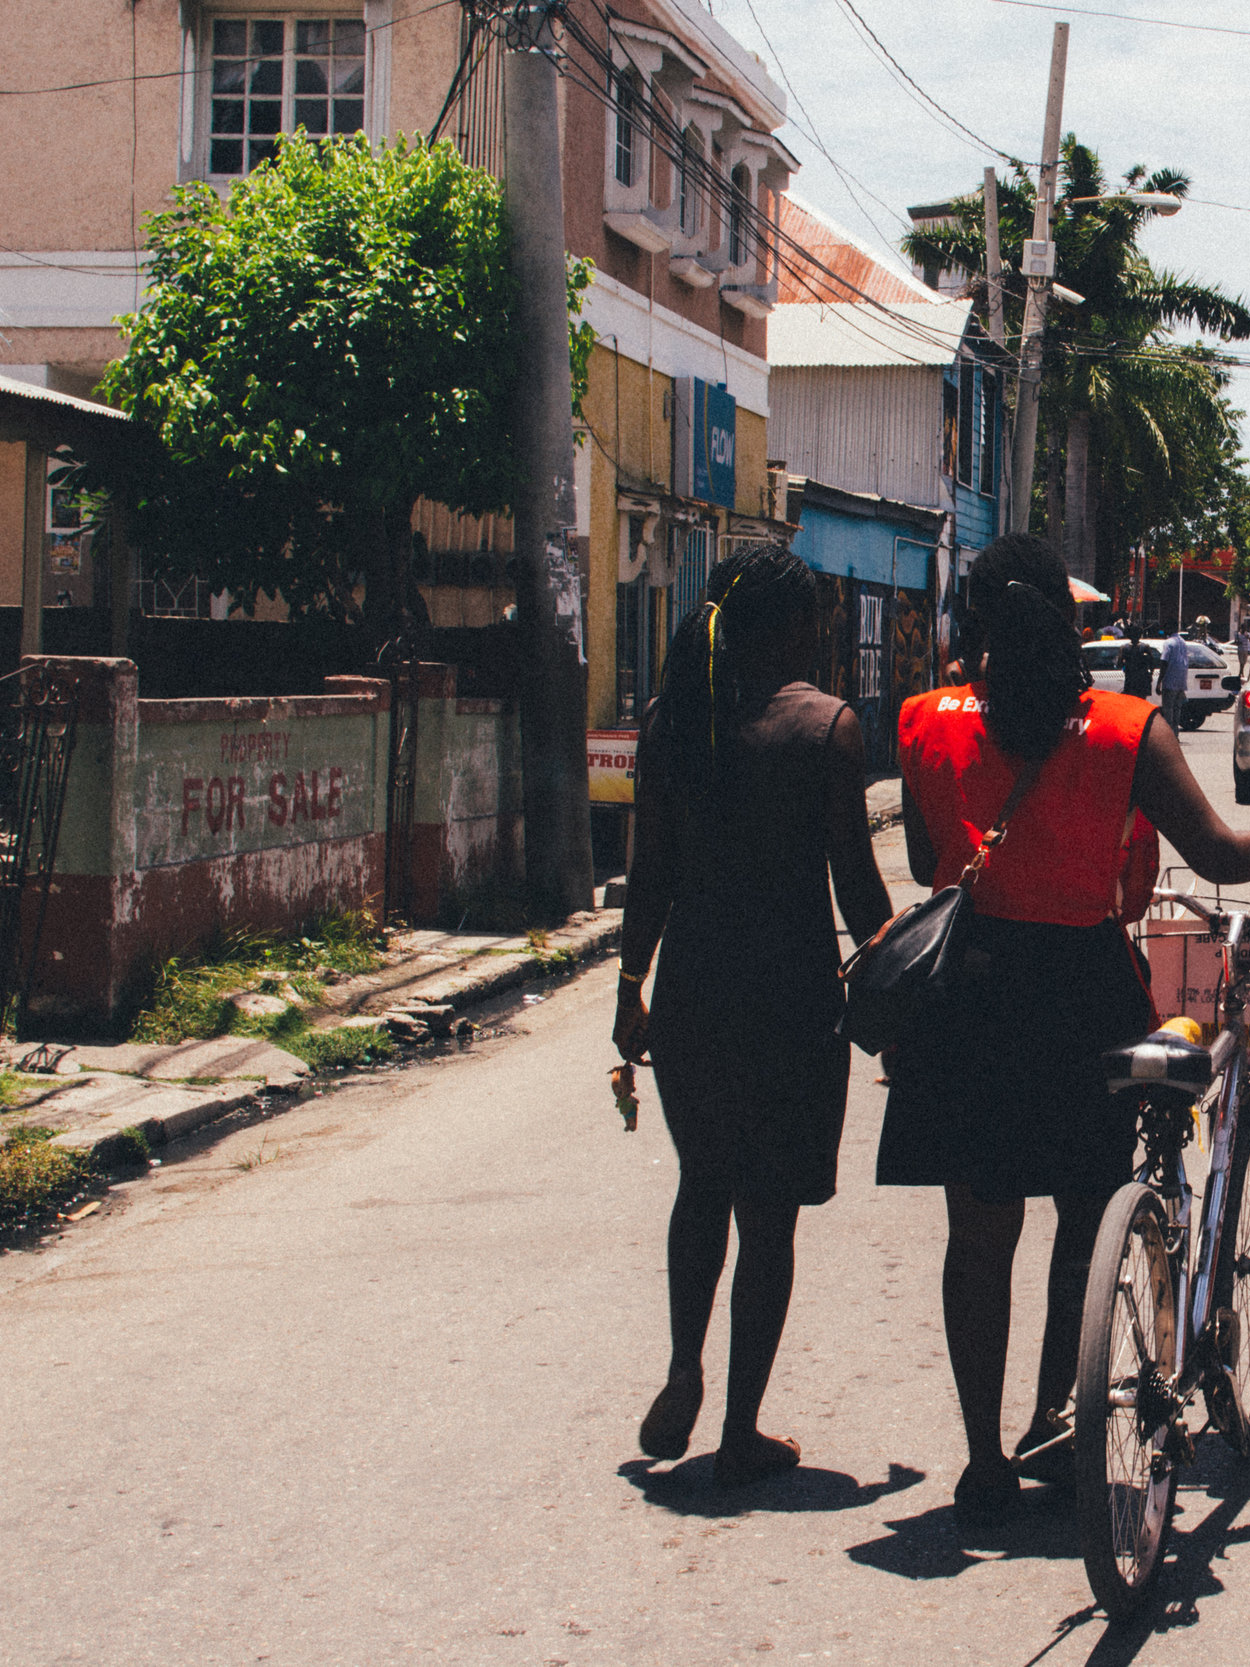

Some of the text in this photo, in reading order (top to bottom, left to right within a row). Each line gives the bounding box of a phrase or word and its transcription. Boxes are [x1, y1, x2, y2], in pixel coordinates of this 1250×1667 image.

[711, 426, 735, 467] FLOW
[859, 649, 881, 698] FIRE
[937, 696, 961, 711] Be
[220, 732, 292, 763] PROPERTY
[181, 767, 342, 836] FOR SALE
